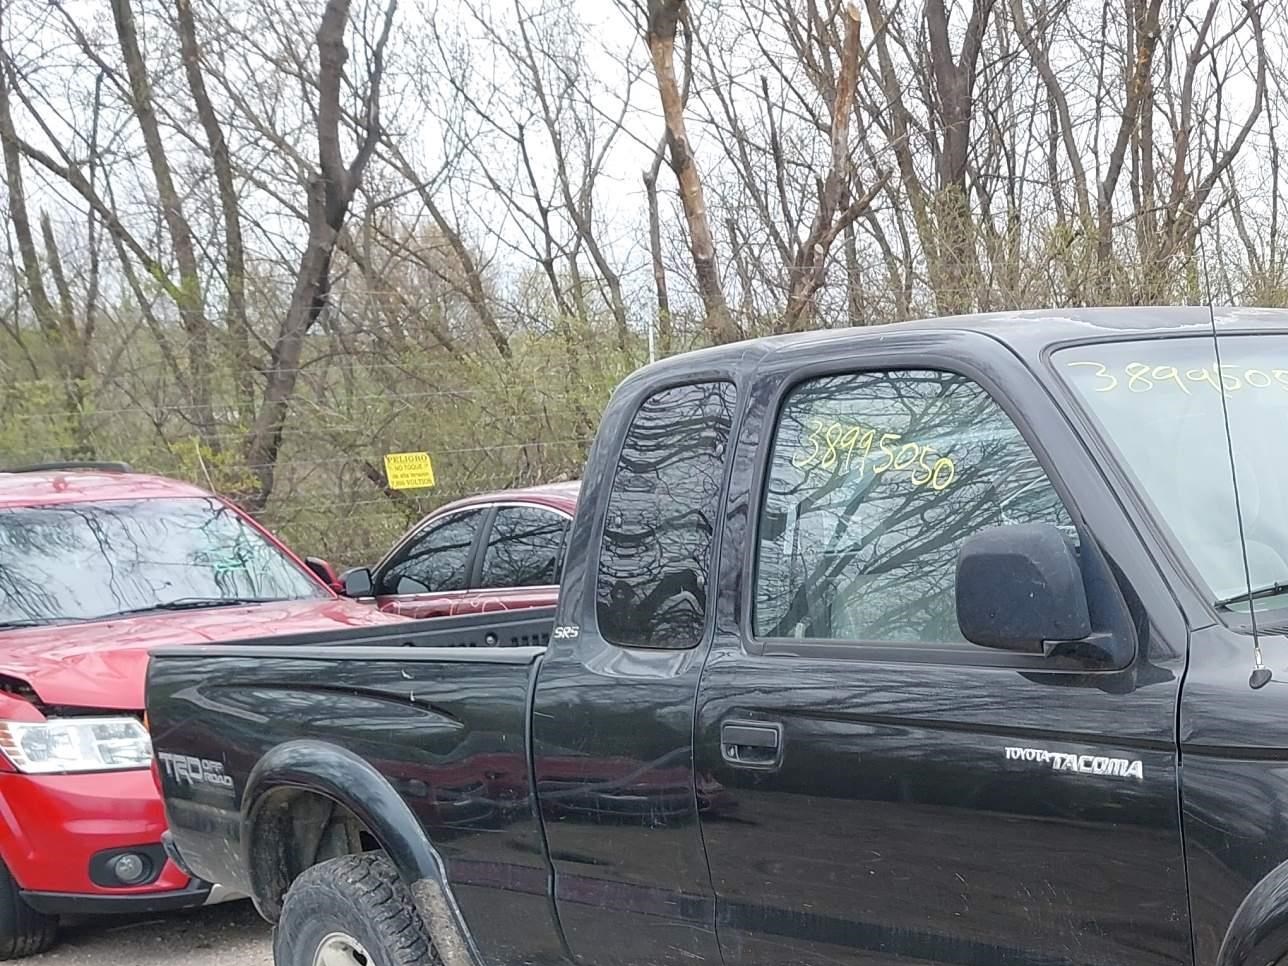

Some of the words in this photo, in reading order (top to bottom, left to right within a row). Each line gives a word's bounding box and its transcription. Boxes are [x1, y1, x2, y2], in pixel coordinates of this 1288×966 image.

[792, 420, 954, 490] 38995050
[554, 626, 580, 639] SRS
[158, 752, 204, 785] TRD
[201, 759, 225, 772] OFF
[1004, 747, 1050, 763] TOYOTA
[1050, 752, 1144, 780] TACOMA
[203, 771, 235, 787] ROAD
